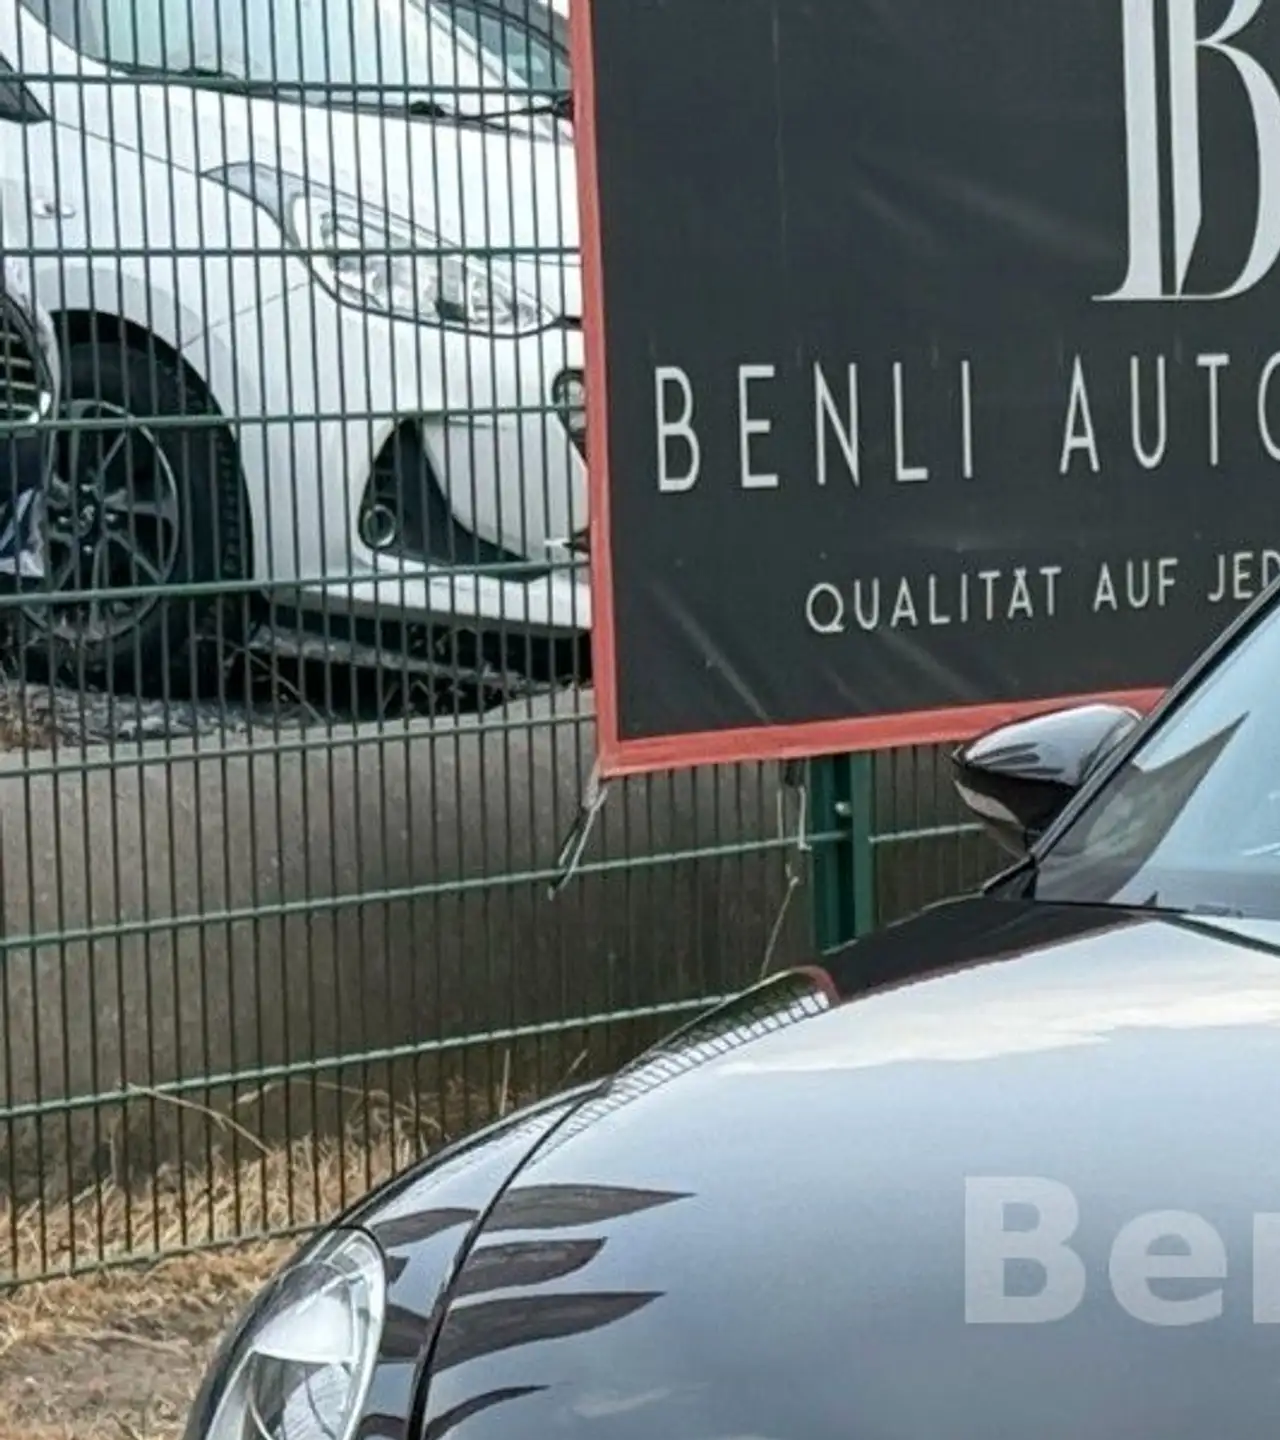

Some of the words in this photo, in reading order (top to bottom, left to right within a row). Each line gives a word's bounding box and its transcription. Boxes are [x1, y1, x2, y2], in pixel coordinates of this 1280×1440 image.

[655, 359, 974, 493] BENLI
[805, 566, 1062, 633] QUALITÄT
[1092, 557, 1179, 613] AUF
